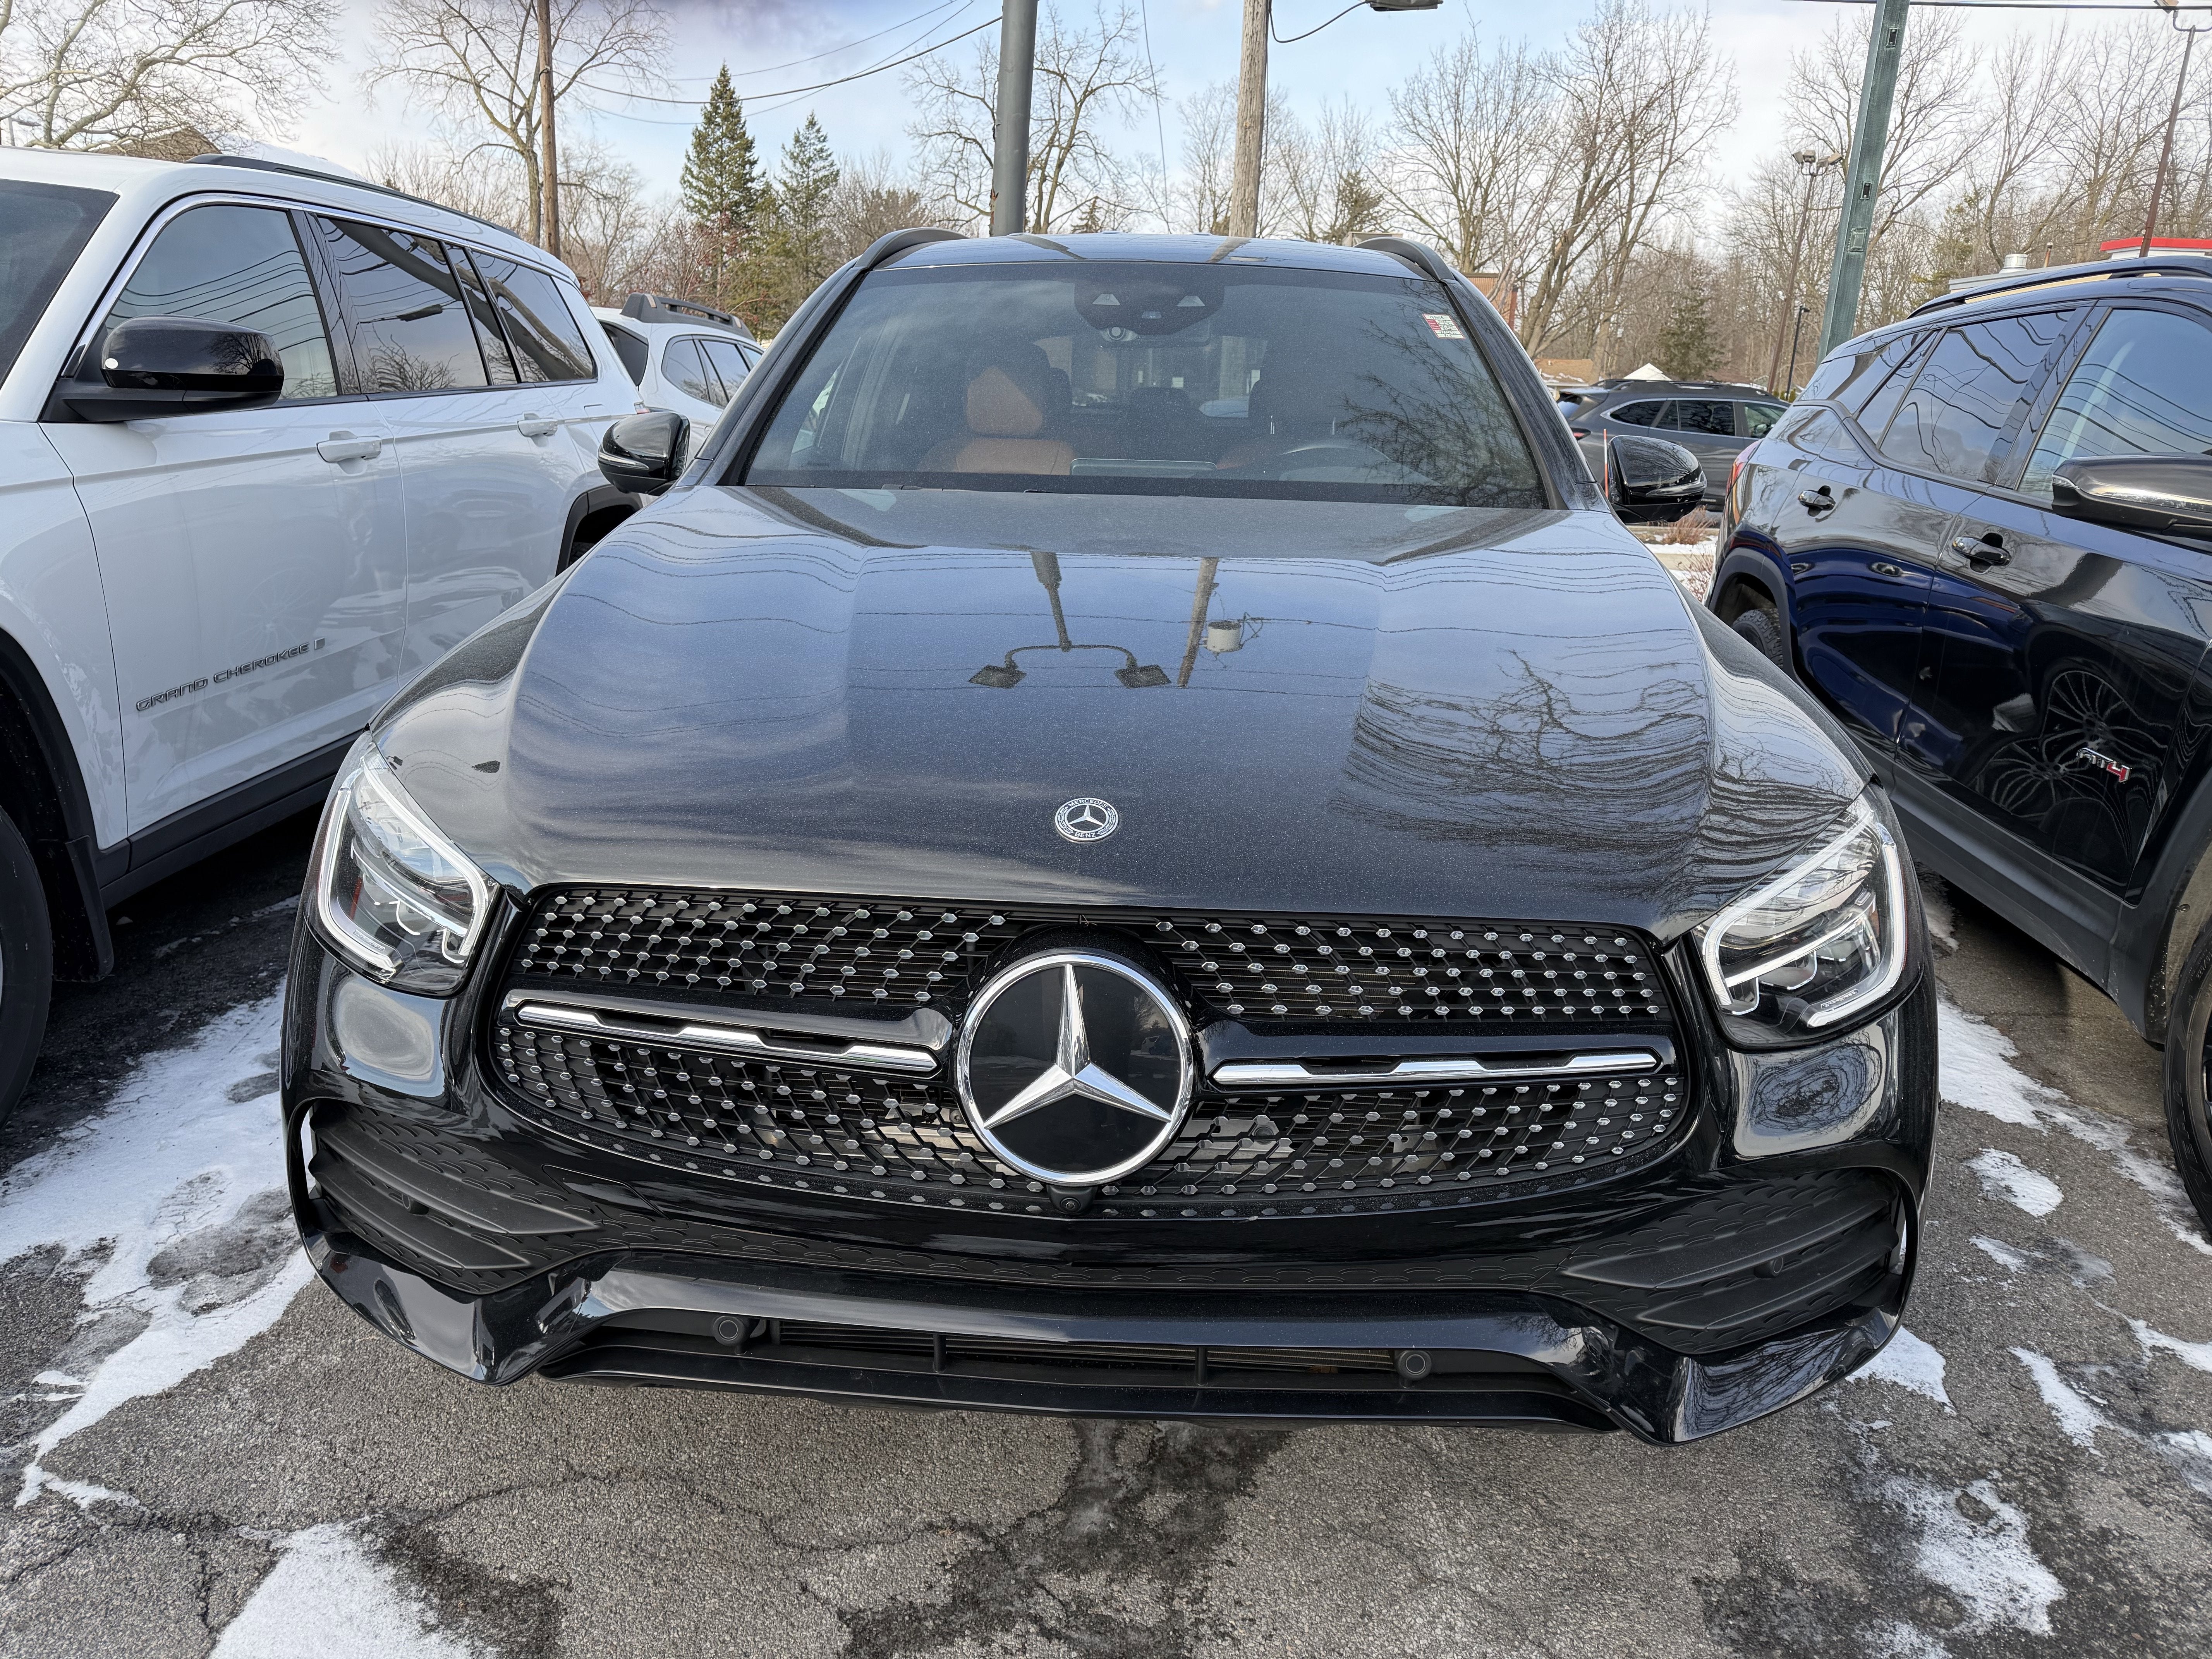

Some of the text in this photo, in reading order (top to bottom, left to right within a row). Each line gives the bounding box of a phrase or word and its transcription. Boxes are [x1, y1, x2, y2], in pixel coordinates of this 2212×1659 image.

[136, 642, 310, 711] GRAND CHEROKEE
[1068, 799, 1108, 808] MERCEDES
